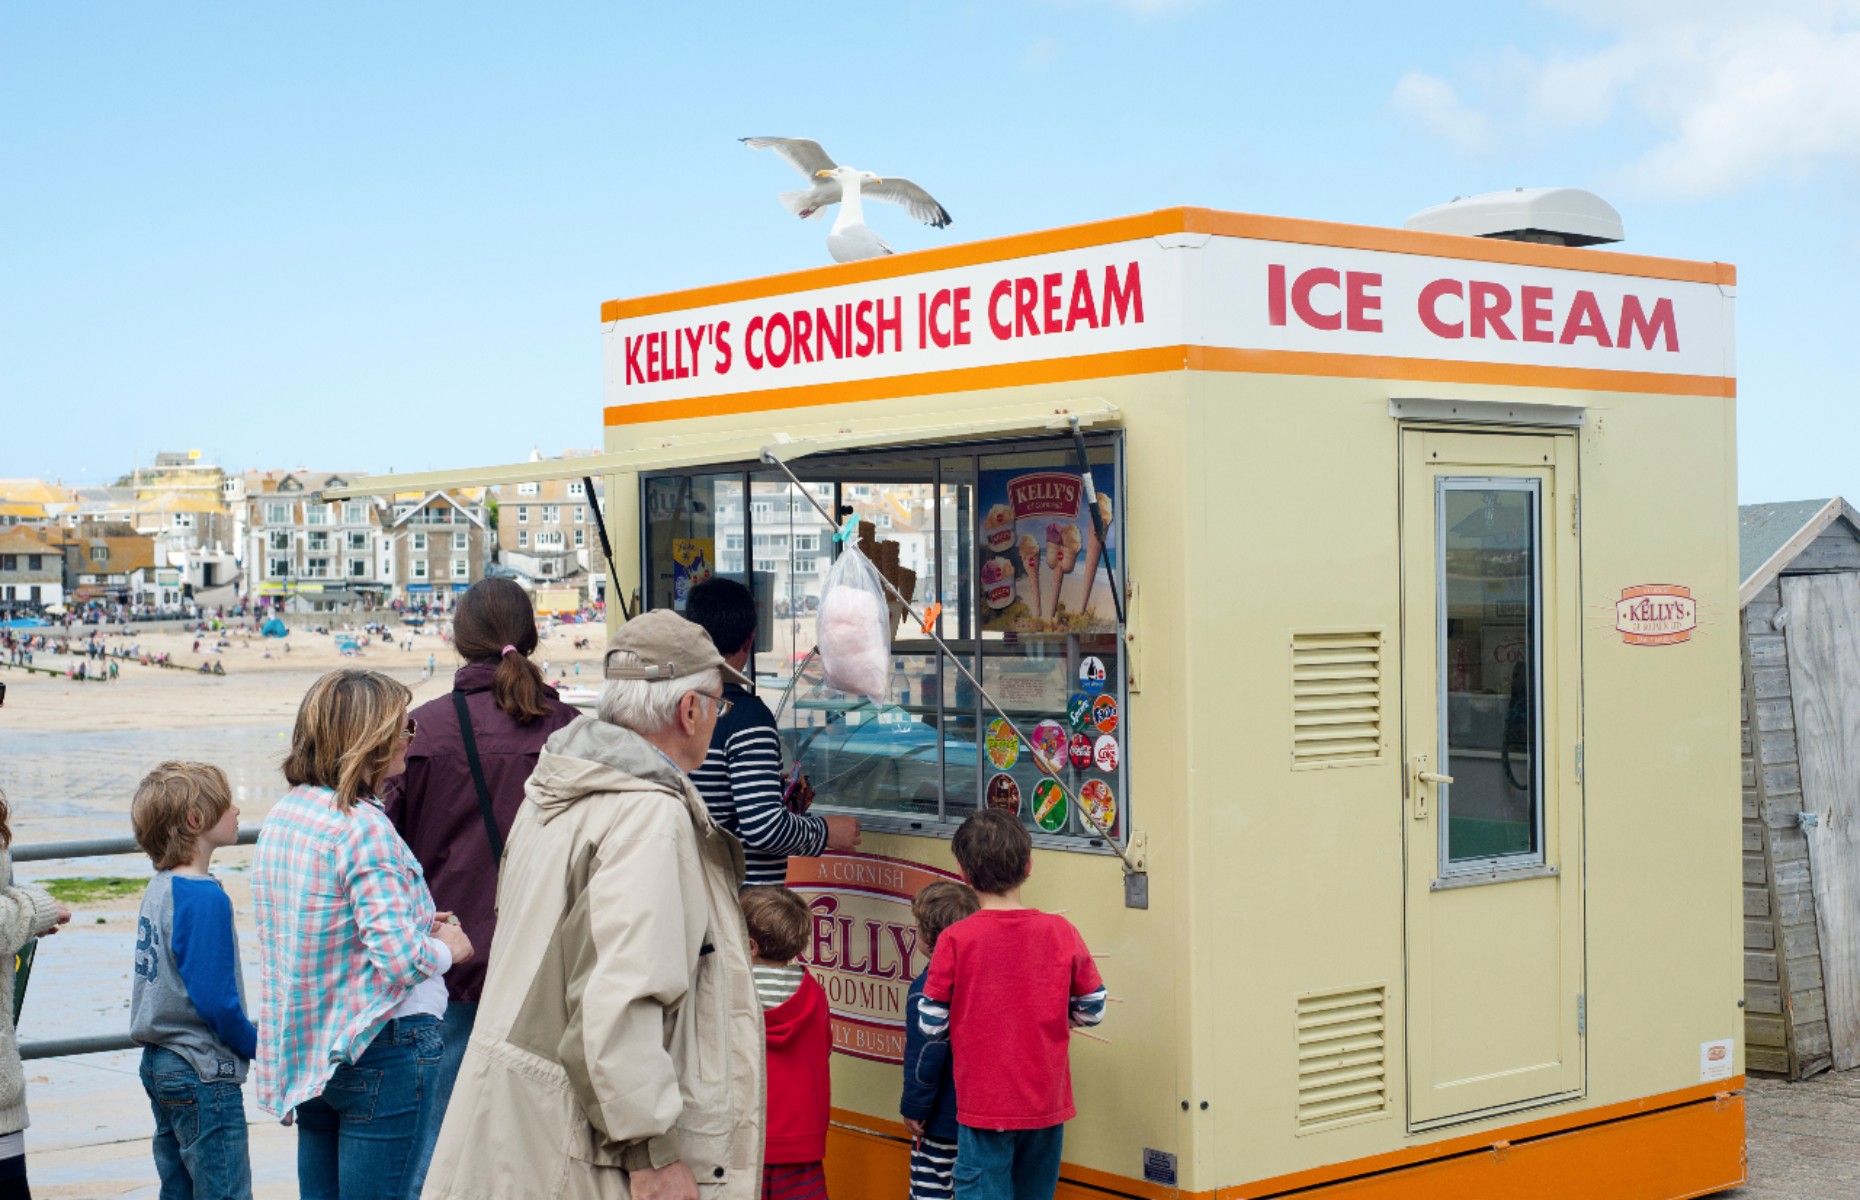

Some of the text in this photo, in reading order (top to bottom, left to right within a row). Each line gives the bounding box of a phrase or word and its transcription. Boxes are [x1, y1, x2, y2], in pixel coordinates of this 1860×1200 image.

[625, 261, 1145, 385] KELLY'S CORNISH ICE CREAM
[1267, 264, 1680, 353] ICE CREAM
[1015, 483, 1075, 504] KELLY'S
[1629, 598, 1685, 621] KELLY'S
[817, 863, 905, 889] A CORNISH
[796, 895, 917, 981] ELLY
[816, 972, 899, 1013] BODMIN
[856, 1029, 907, 1053] BUSIN
